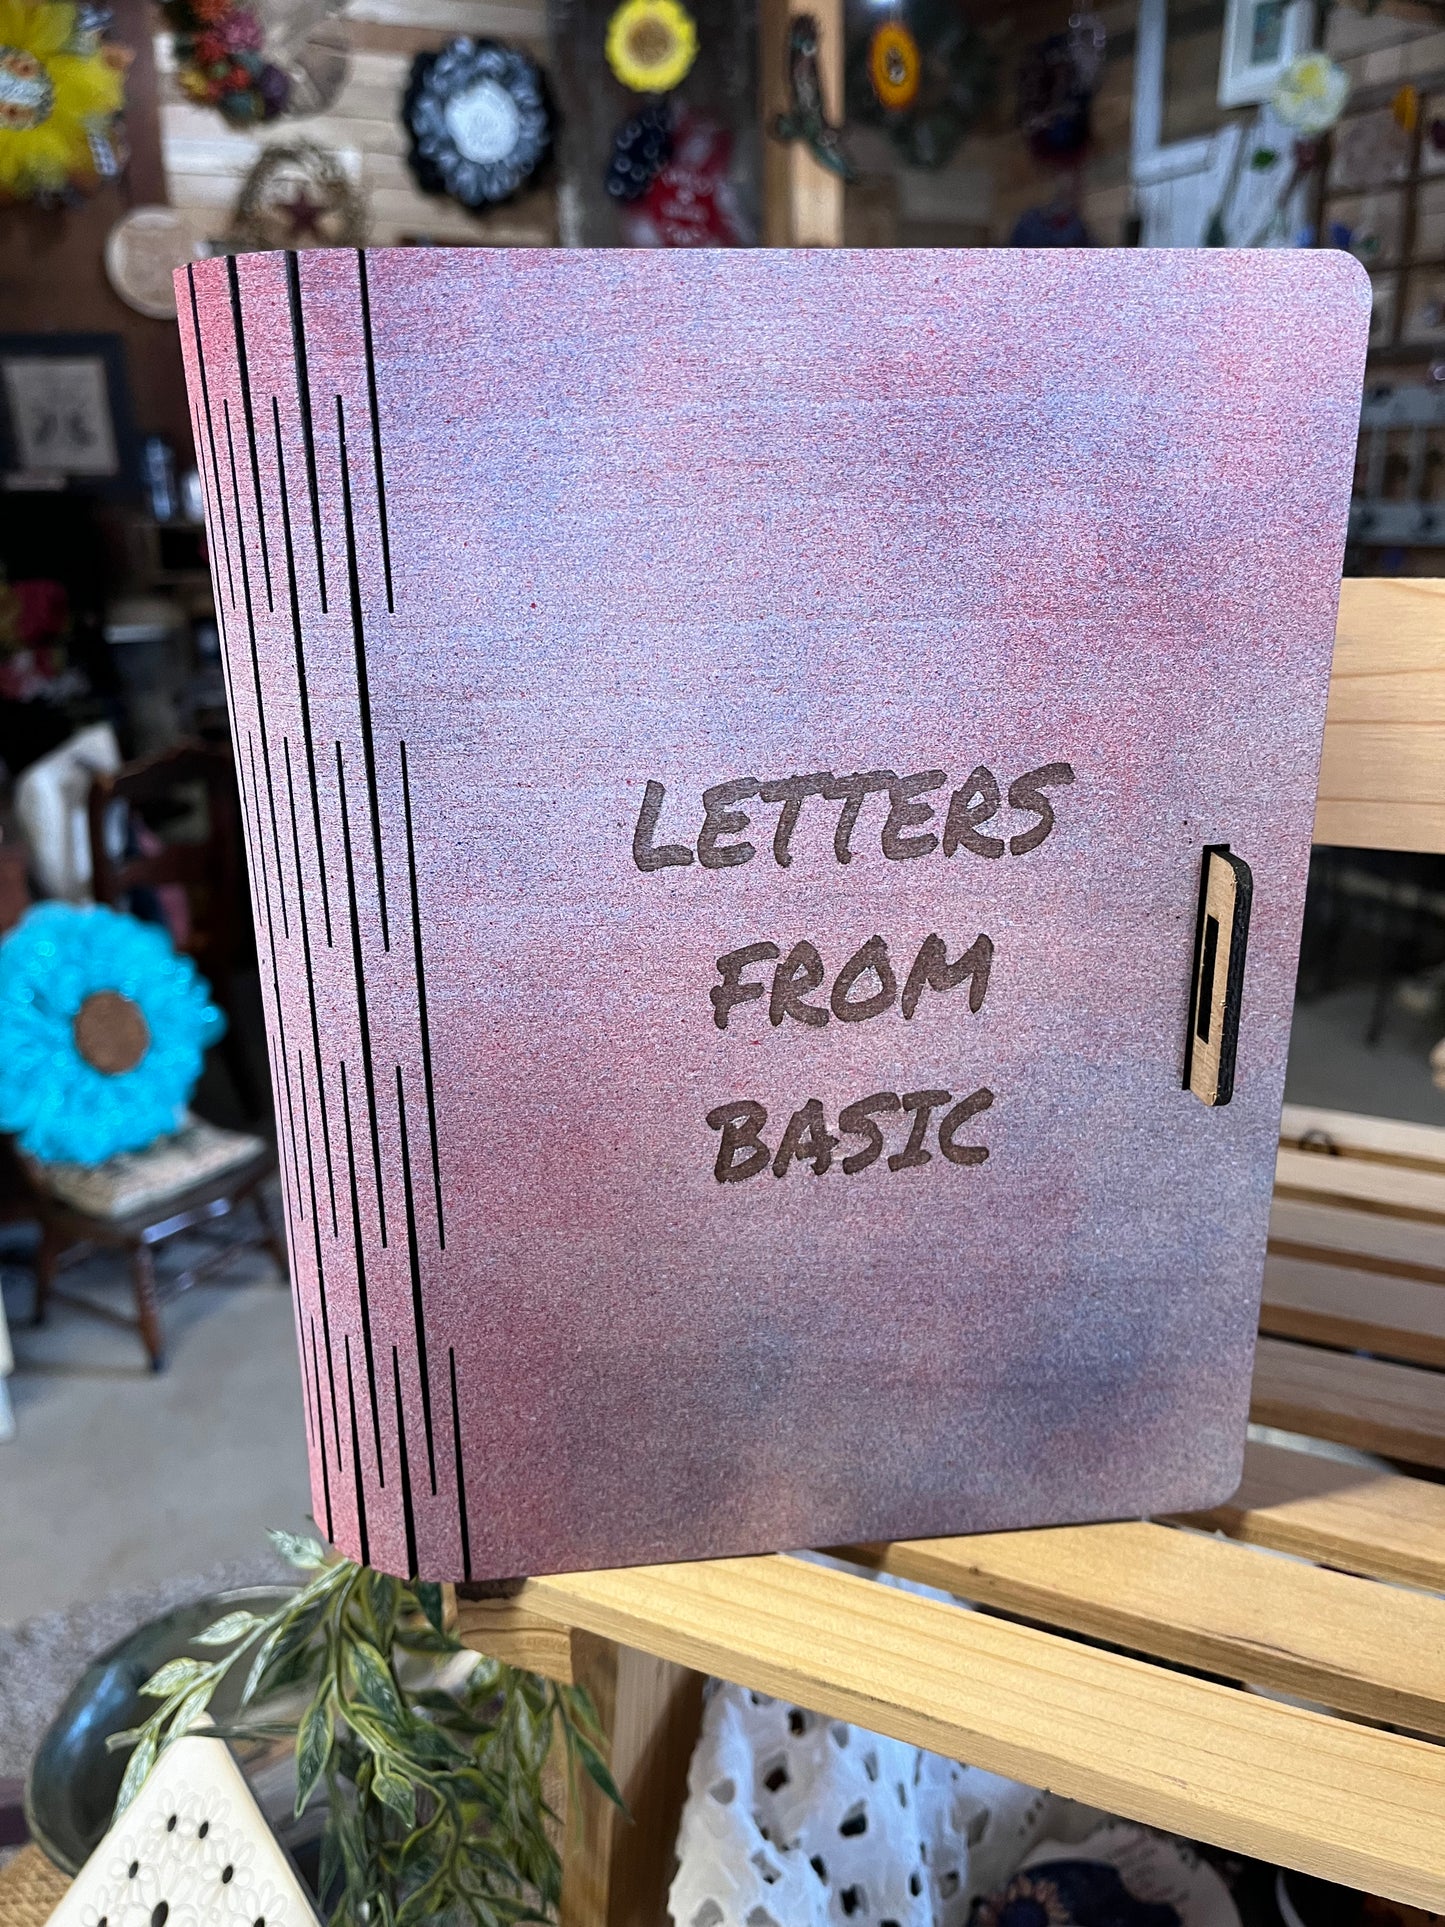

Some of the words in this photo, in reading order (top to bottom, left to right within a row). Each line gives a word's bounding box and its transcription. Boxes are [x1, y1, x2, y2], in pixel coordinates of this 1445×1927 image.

[632, 763, 1075, 872] LETTERS
[710, 933, 995, 1030] FROM
[705, 1087, 995, 1184] BASIC
